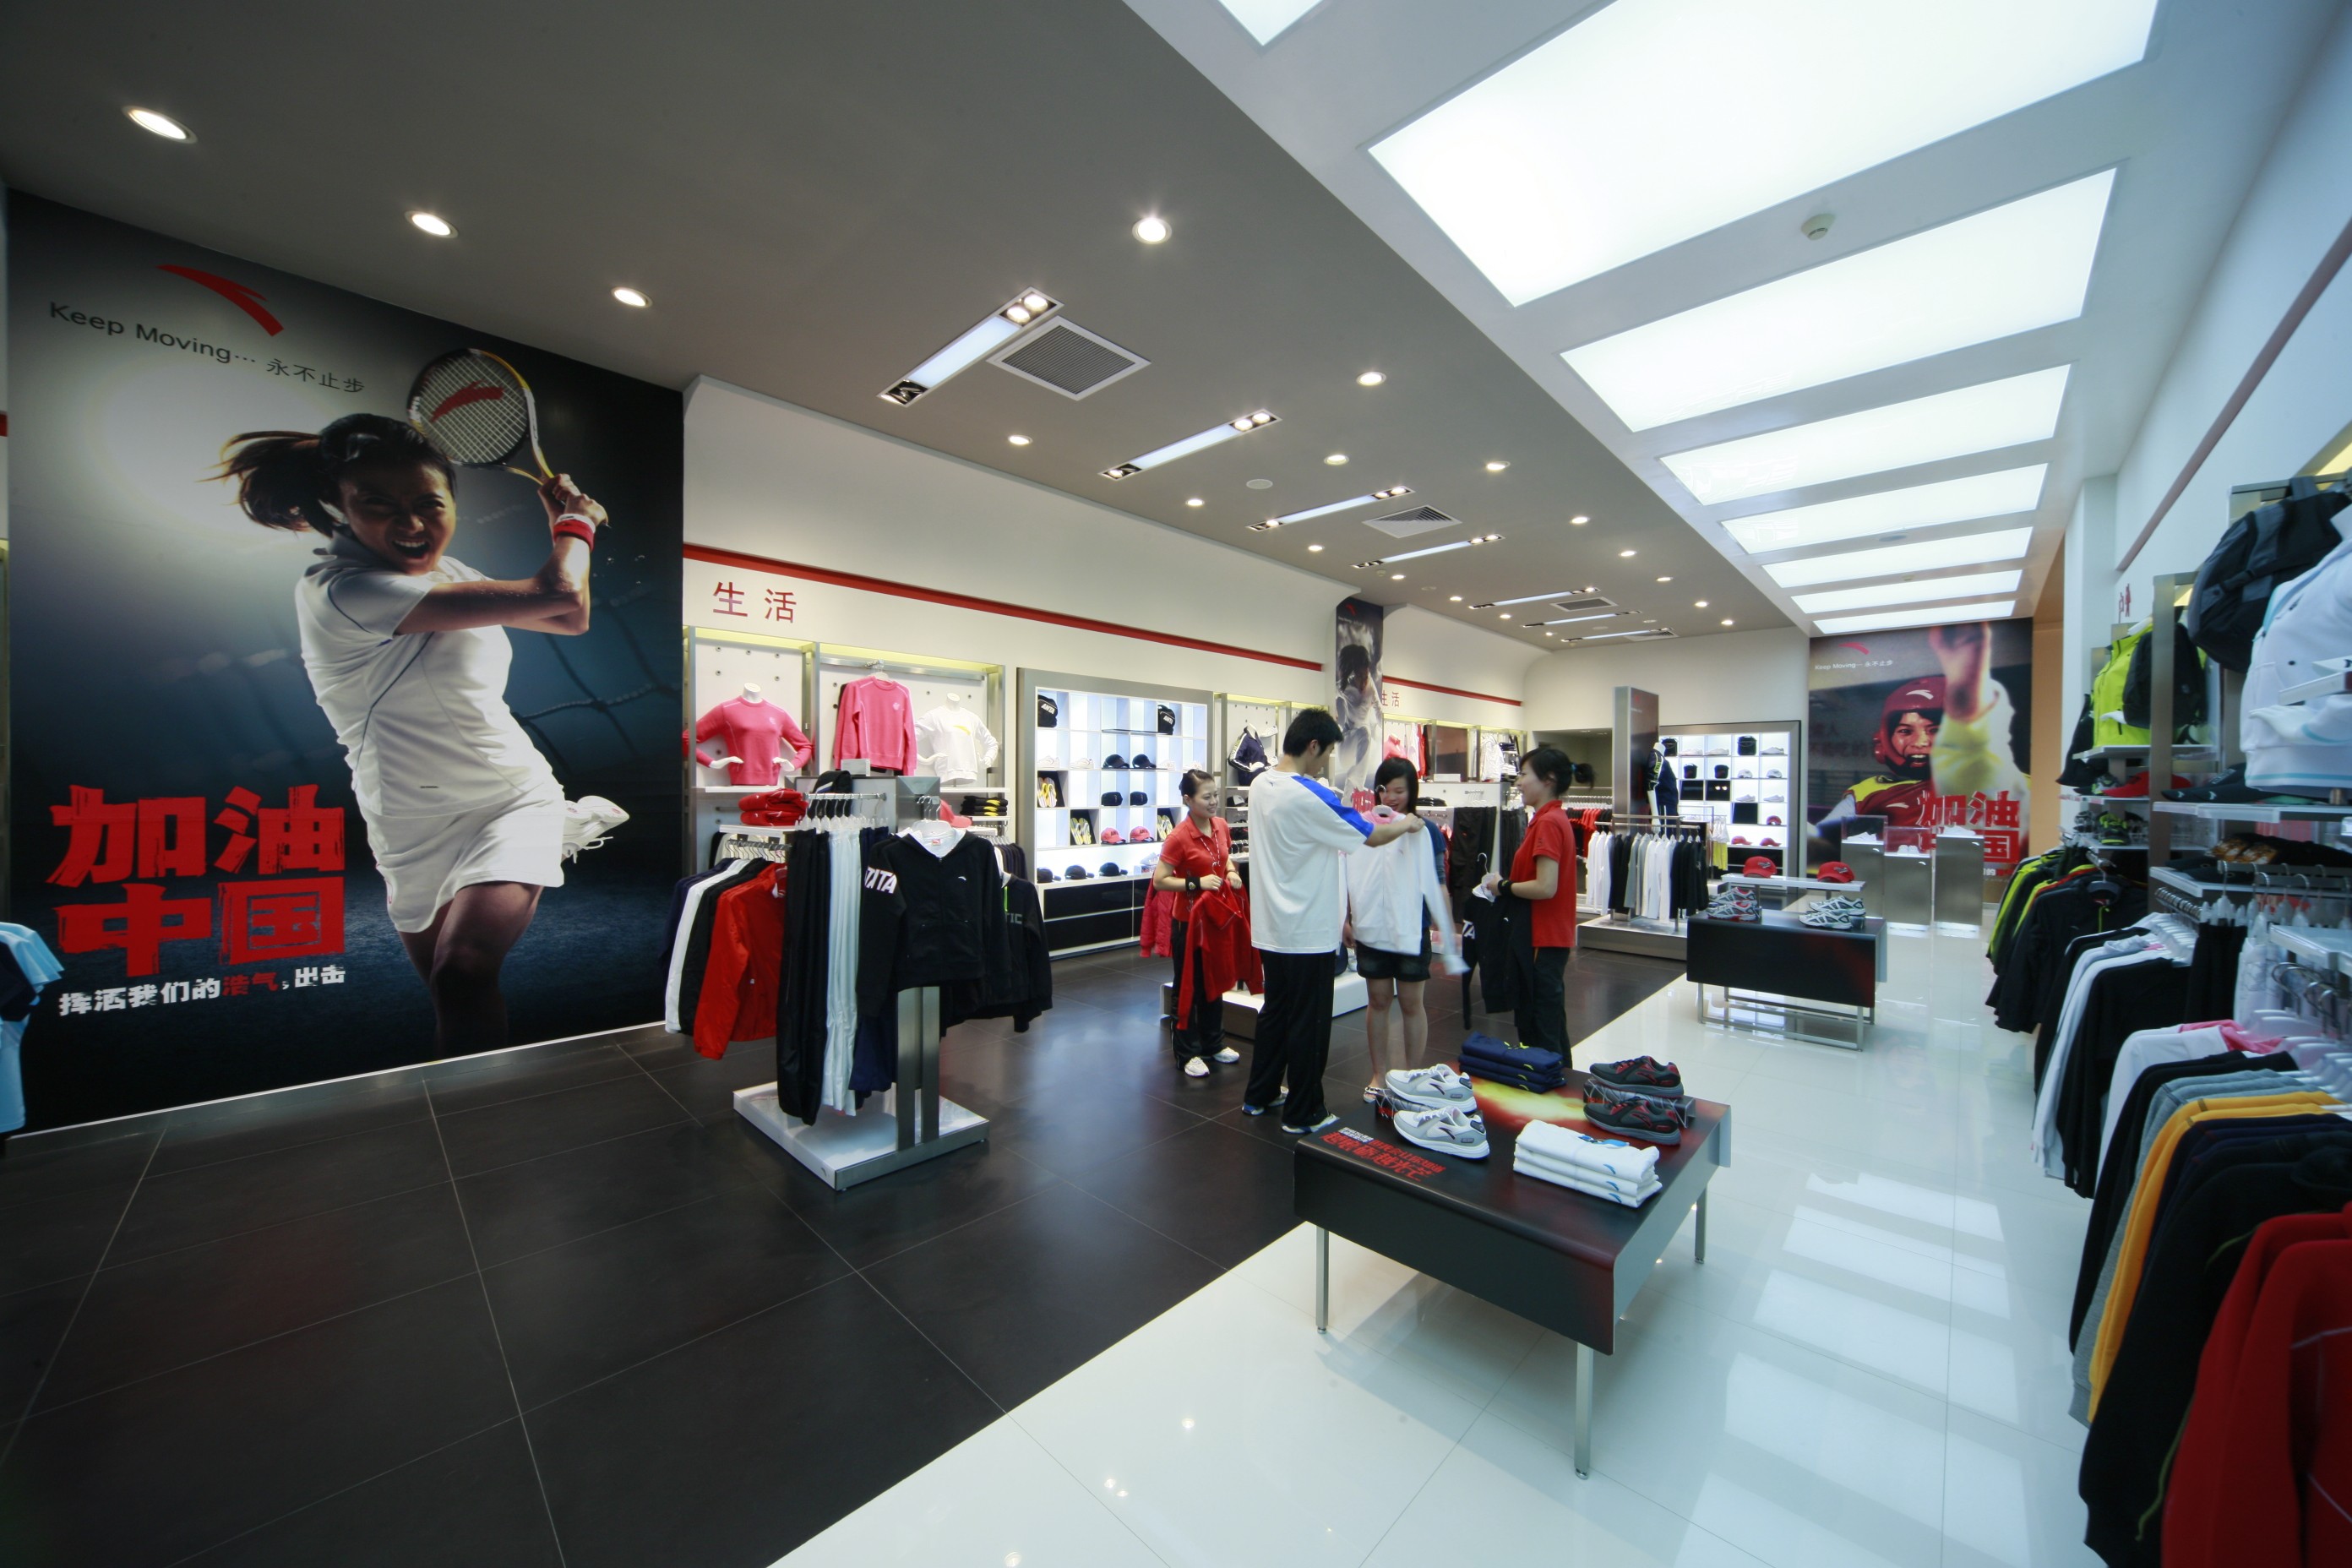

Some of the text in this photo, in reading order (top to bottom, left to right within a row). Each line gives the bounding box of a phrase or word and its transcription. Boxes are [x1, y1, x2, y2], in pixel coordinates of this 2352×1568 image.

[50, 302, 124, 336] Keep
[267, 358, 365, 394] 永不止步
[713, 581, 798, 623] 生活
[45, 784, 345, 888] 加油
[1915, 790, 2020, 828] 加油
[54, 876, 345, 977] 中国
